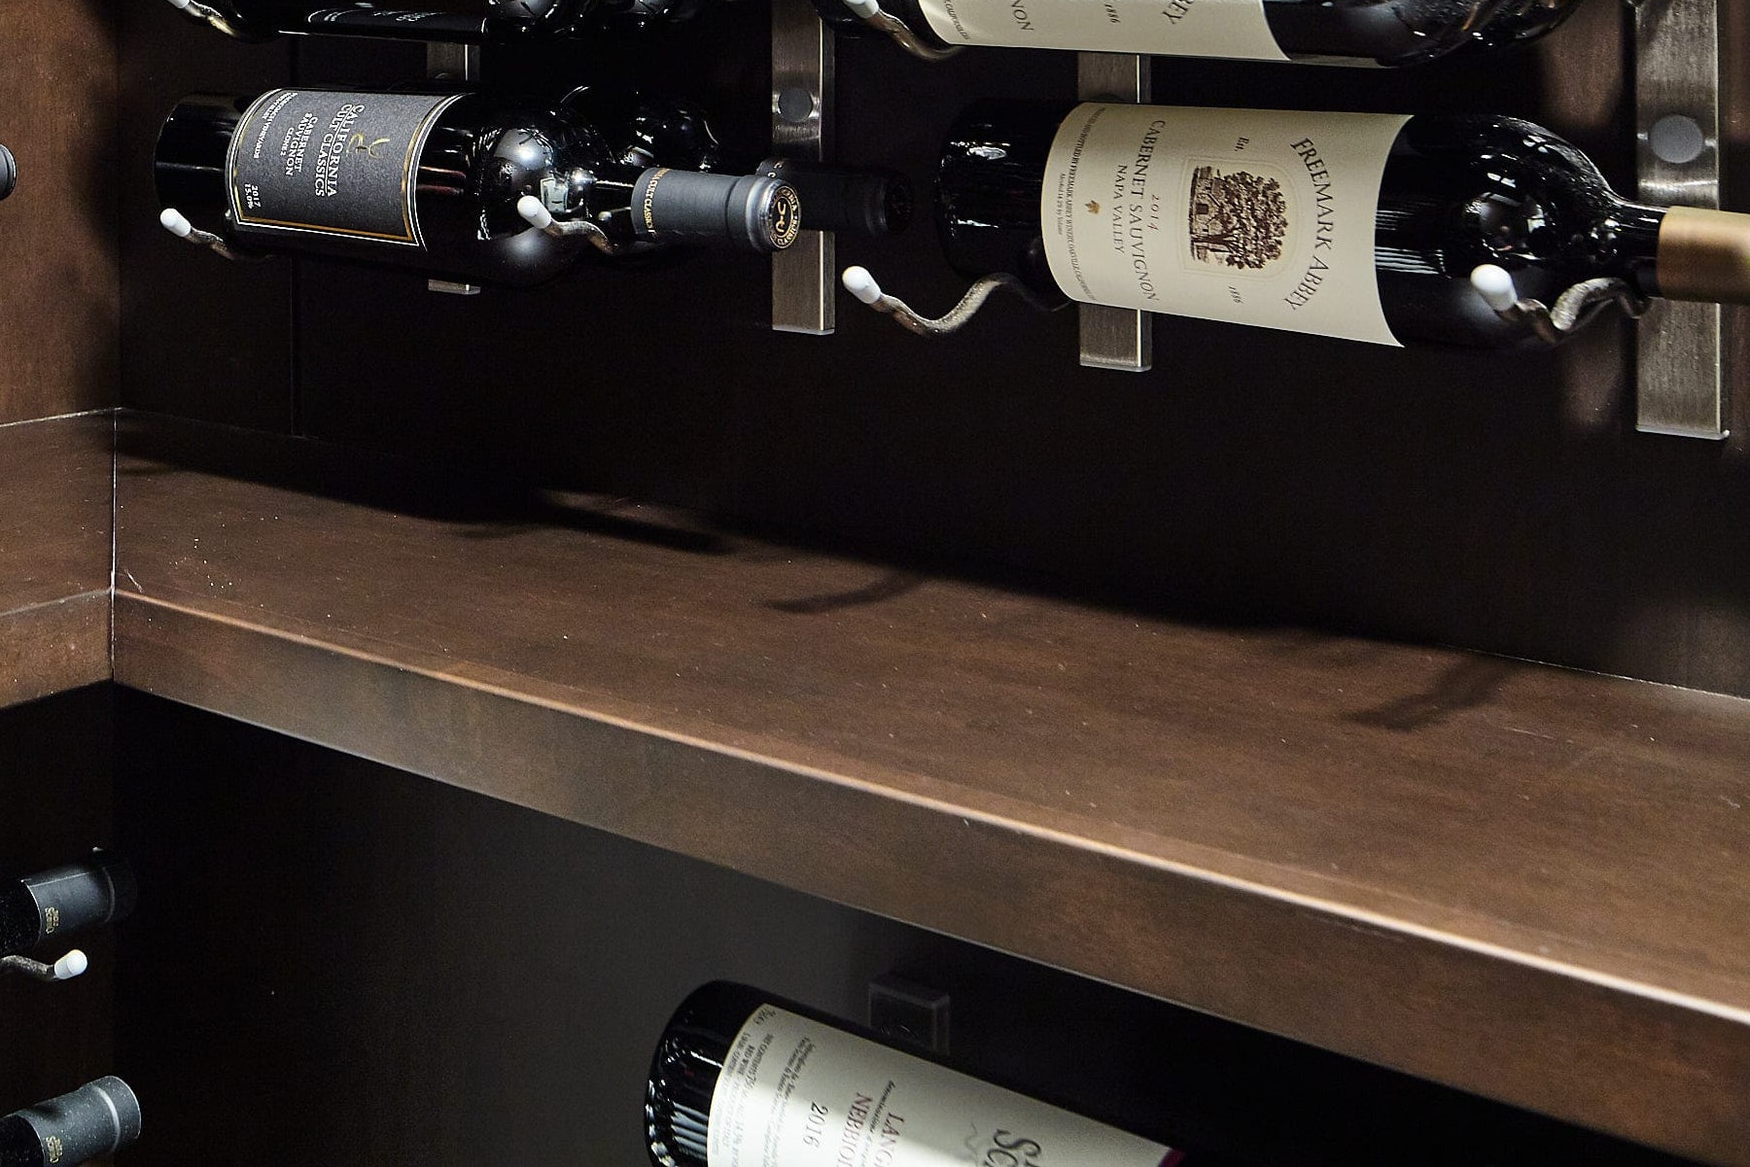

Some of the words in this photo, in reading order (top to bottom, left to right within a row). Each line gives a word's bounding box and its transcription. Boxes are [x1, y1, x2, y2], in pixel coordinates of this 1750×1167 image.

[294, 115, 319, 173] CABERNET
[329, 103, 353, 130] CULT
[314, 133, 334, 198] CLASSICS
[326, 104, 366, 197] CALIFORNIA
[1129, 119, 1167, 198] CABERNET
[251, 185, 262, 209] 2017
[1113, 164, 1128, 203] NAPA
[1290, 137, 1334, 251] FREEMARK
[1113, 205, 1126, 254] VALLEY
[1148, 193, 1161, 231] 2014
[1128, 203, 1161, 303] SAUVIGNON
[1284, 255, 1330, 311] ABBEY
[803, 1101, 828, 1148] 2016
